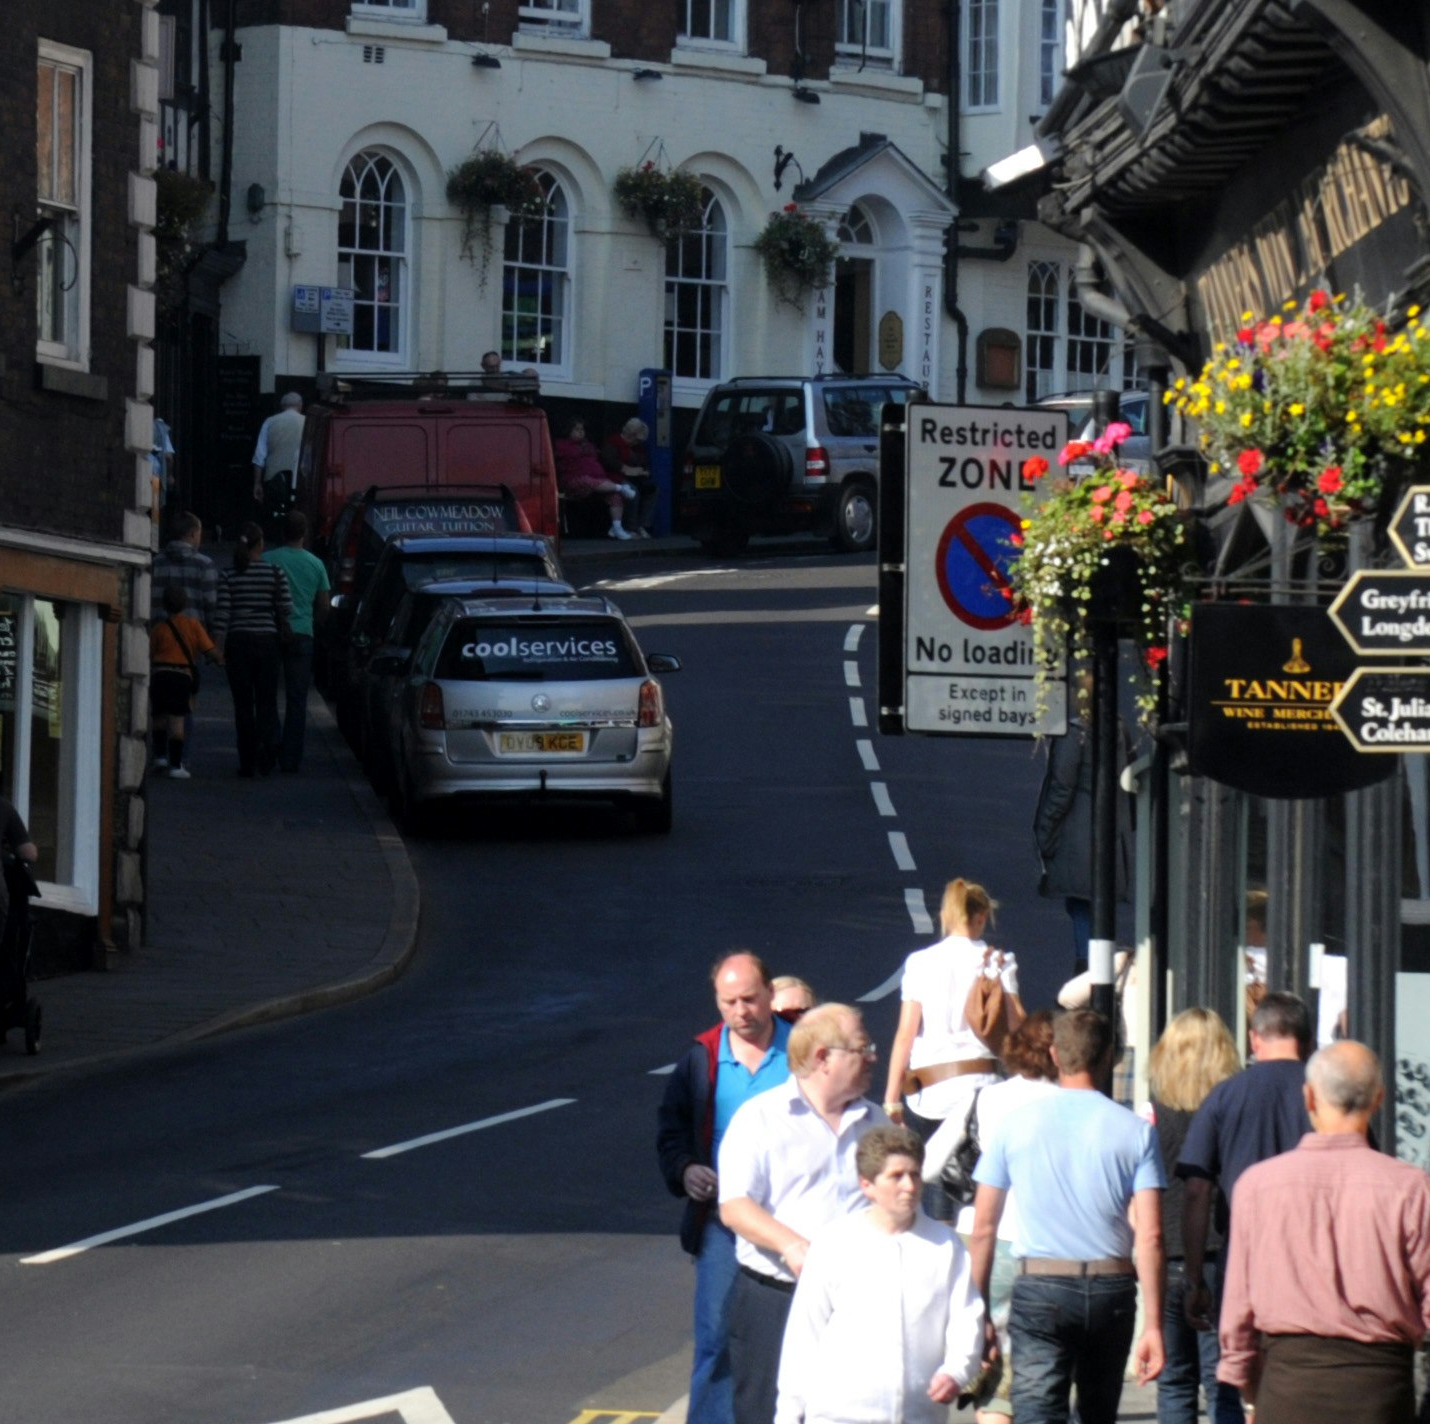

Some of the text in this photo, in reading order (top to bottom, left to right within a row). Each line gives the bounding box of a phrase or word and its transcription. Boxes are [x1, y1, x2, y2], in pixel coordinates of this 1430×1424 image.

[640, 376, 652, 397] P
[920, 418, 1057, 450] Restricted
[938, 457, 1036, 491] ZONE
[373, 504, 505, 521] NEIL COWMEADOW
[385, 521, 495, 532] GUITAR TUITION
[461, 636, 617, 657] coolservices
[916, 636, 952, 663] No
[949, 683, 1026, 704] Except in
[939, 707, 1036, 727] signed bays
[1222, 707, 1265, 719] WINE
[1361, 697, 1388, 718] St.
